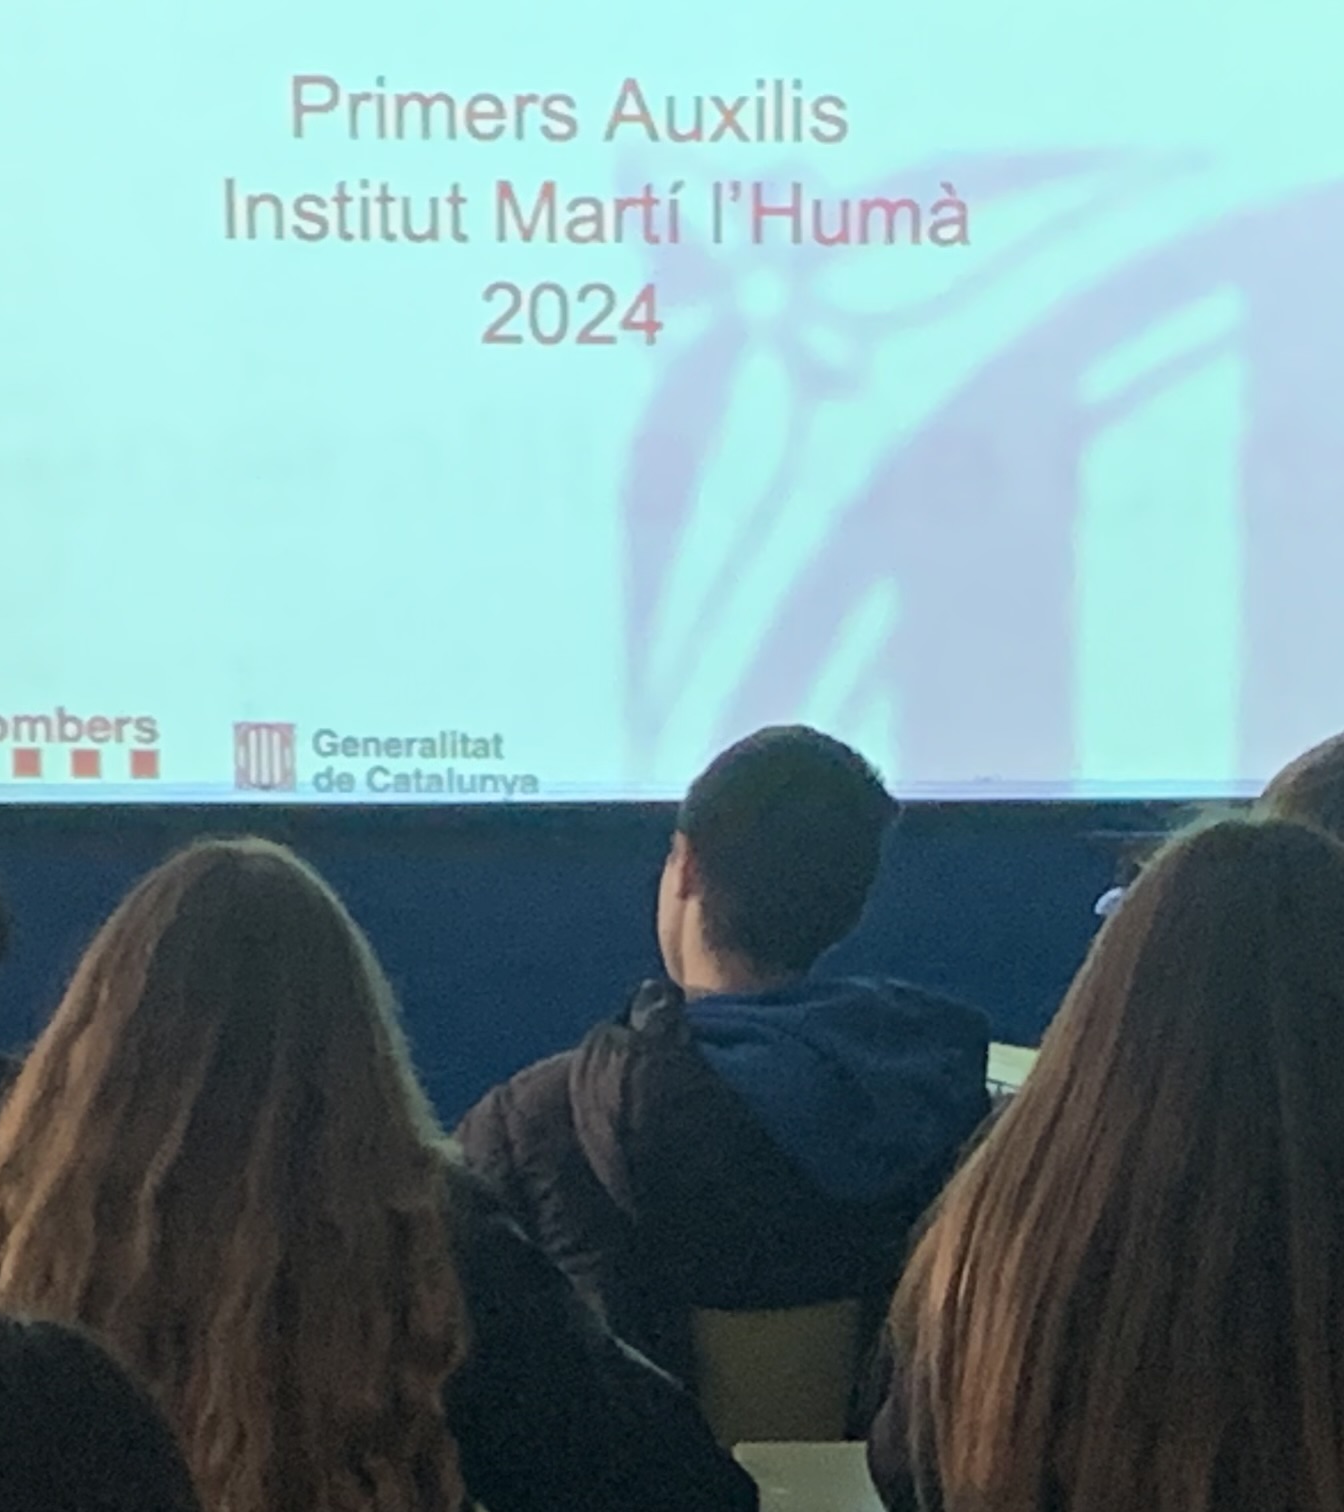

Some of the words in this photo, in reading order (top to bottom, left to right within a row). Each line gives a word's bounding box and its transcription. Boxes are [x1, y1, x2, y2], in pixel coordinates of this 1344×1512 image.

[290, 74, 579, 144] Primers
[602, 76, 850, 145] Auxilis
[222, 176, 470, 244] Institut
[494, 178, 683, 246] Martí
[480, 280, 664, 347] 2024
[311, 727, 505, 762] Generalitat
[312, 765, 356, 795] de
[365, 766, 540, 796] Catalunya
